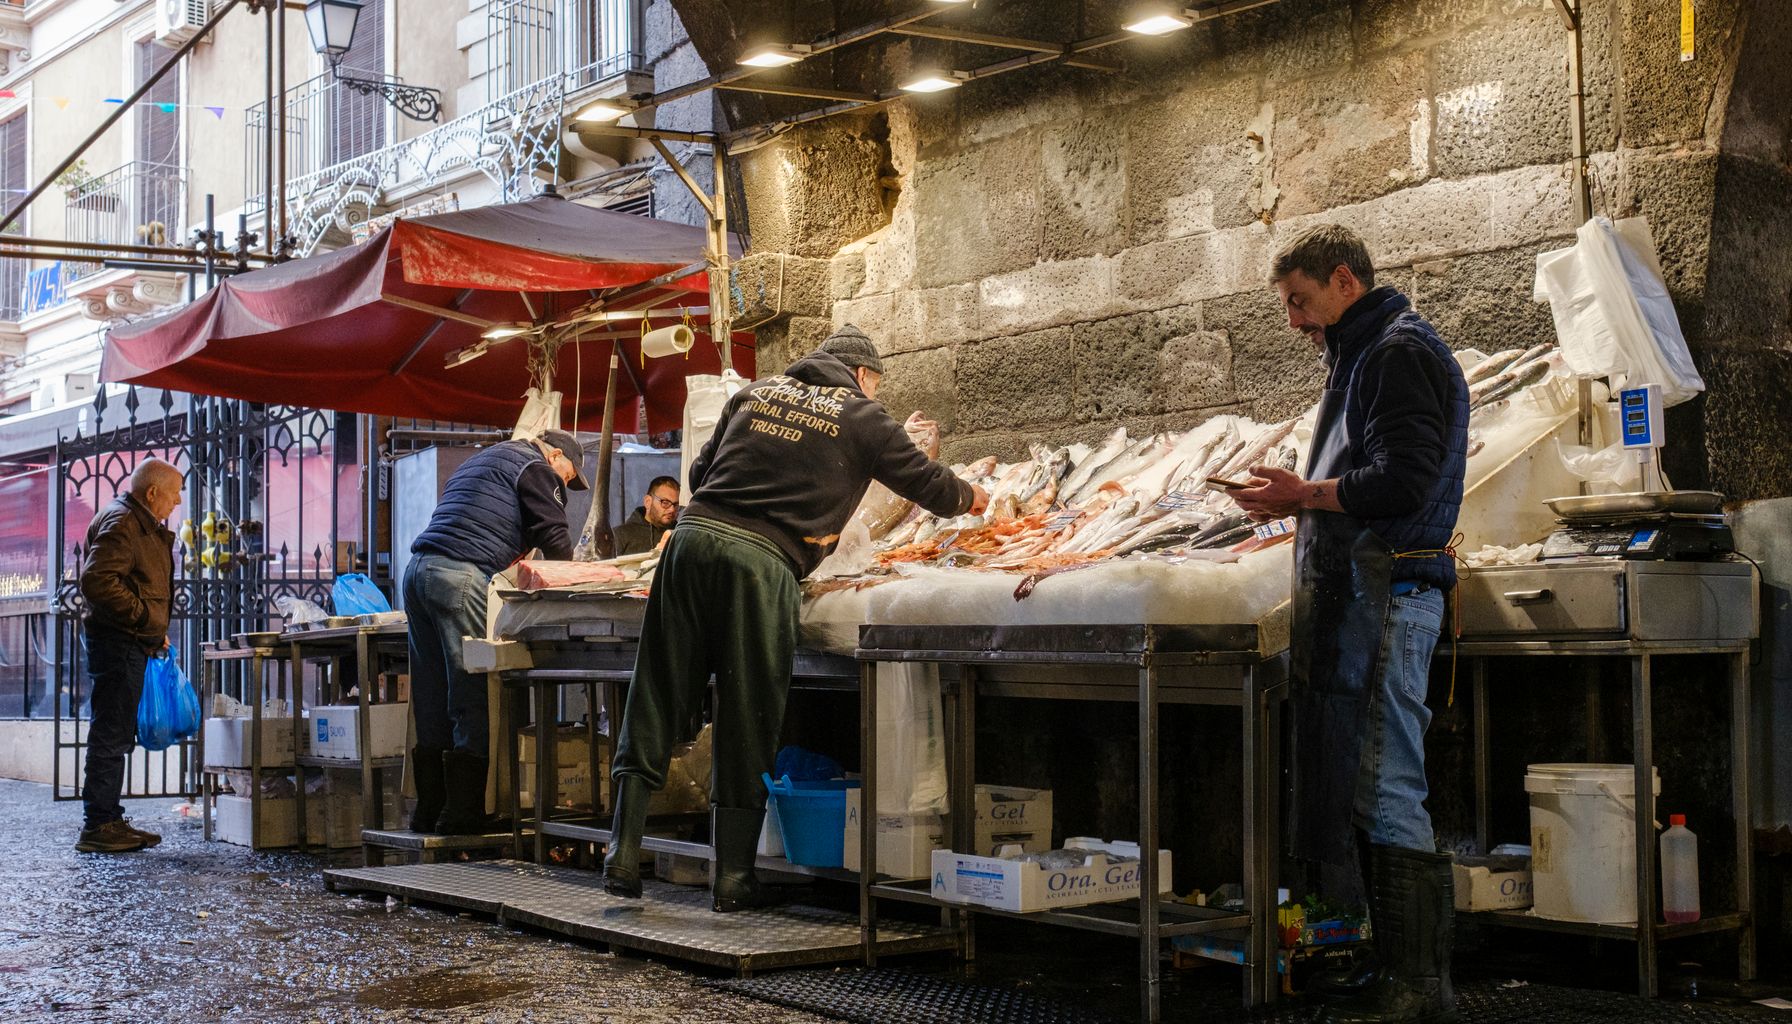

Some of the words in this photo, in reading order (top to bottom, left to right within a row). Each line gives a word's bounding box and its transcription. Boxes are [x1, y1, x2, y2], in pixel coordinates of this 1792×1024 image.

[753, 387, 800, 406] RITICAL
[738, 400, 782, 419] NATURAL
[785, 409, 841, 438] EFFORTS
[749, 418, 803, 442] TRUSTED
[849, 807, 858, 825] A
[992, 803, 1026, 819] Gel
[935, 871, 947, 893] A
[1048, 872, 1097, 891] Ora.
[1105, 864, 1141, 885] Gel
[1117, 883, 1141, 892] ITALI
